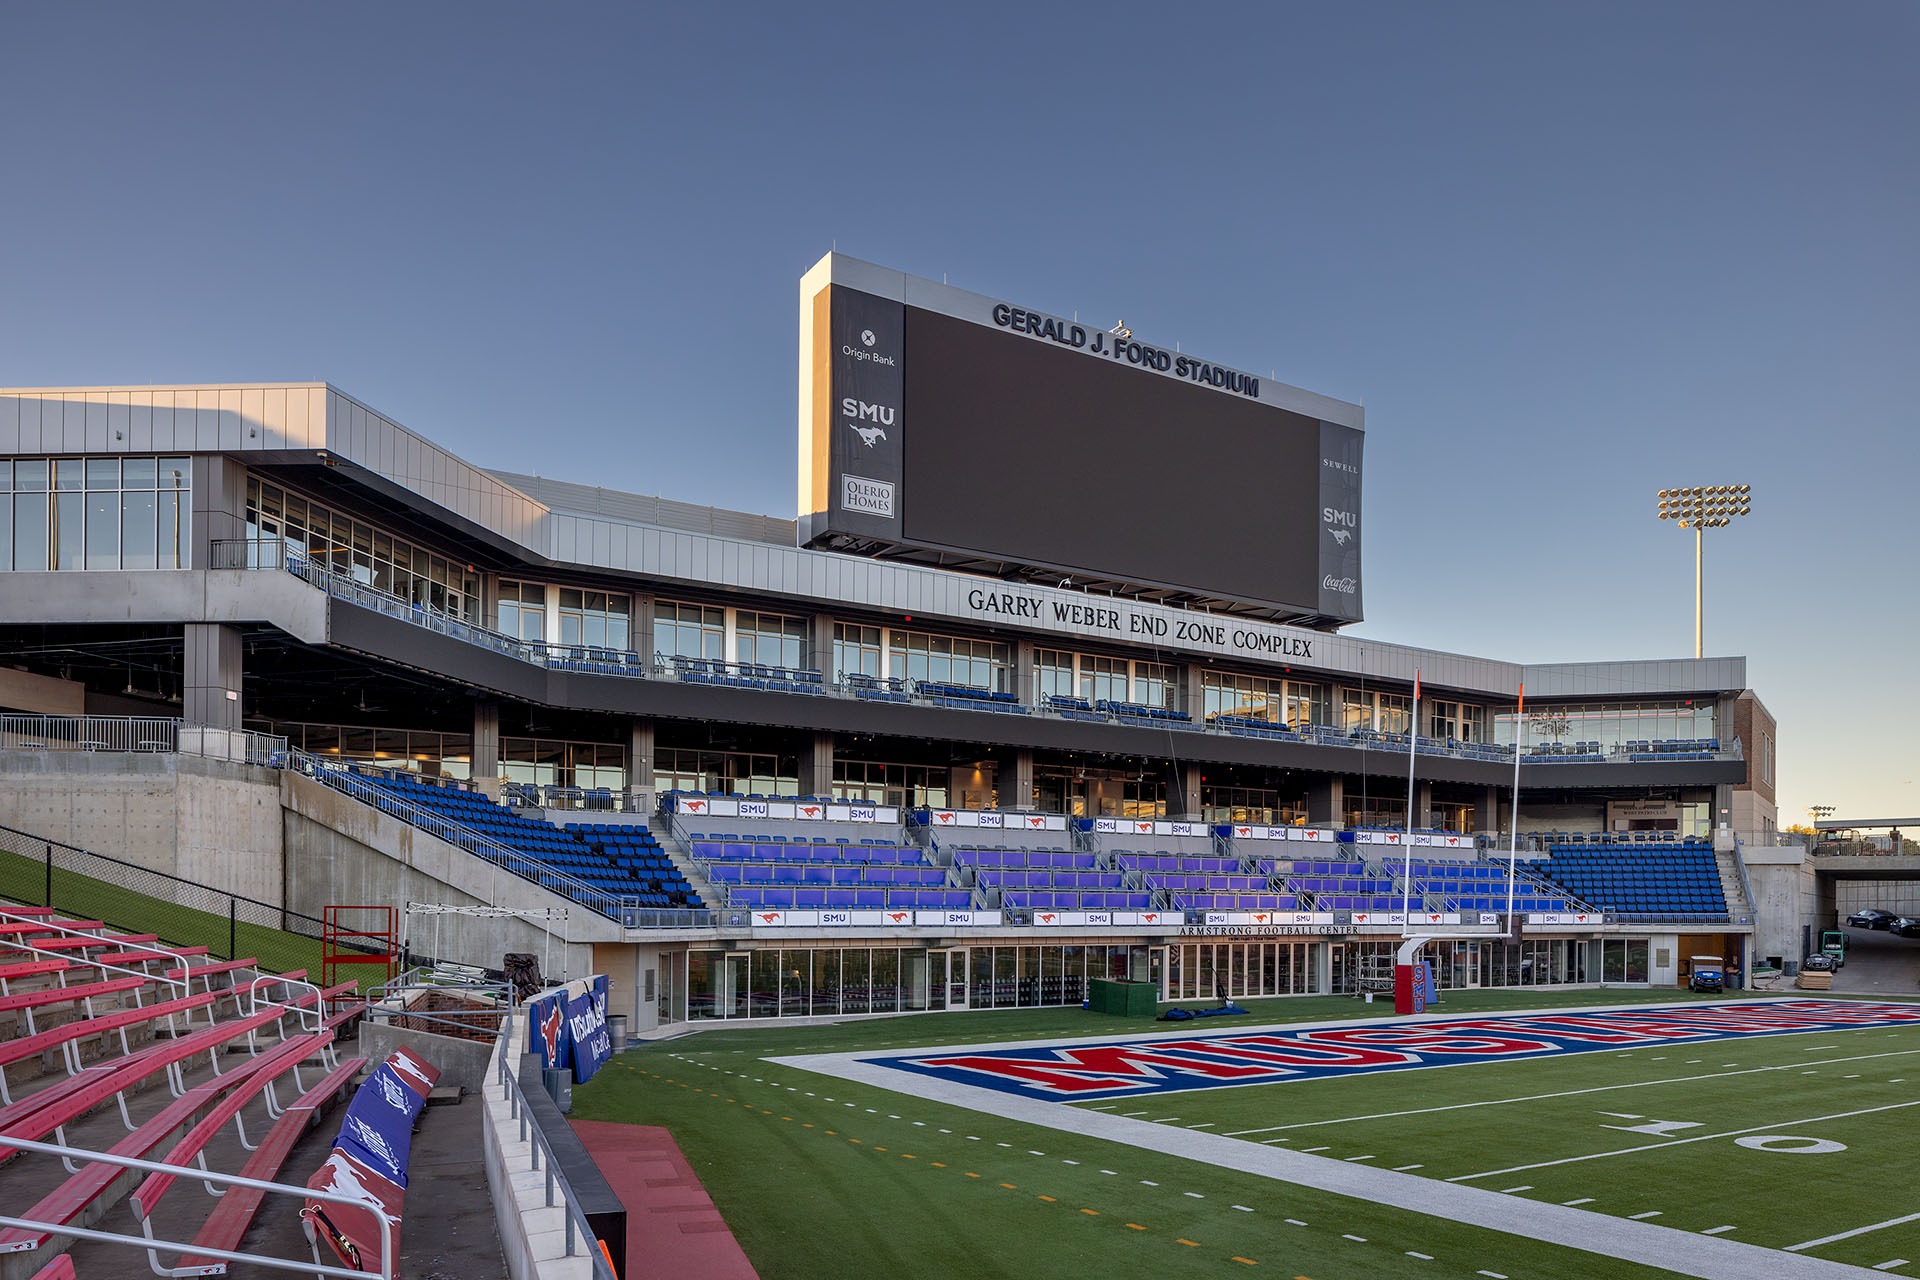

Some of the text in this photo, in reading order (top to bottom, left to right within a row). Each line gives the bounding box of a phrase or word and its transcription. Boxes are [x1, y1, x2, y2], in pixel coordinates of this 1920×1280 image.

[842, 345, 895, 367] Origin Bank
[993, 304, 1259, 398] GERALD J. FORD STADIUM
[842, 398, 895, 426] SMU
[1323, 458, 1358, 474] SEWELL
[847, 480, 890, 499] OLERIO
[848, 492, 889, 511] HOMES
[1323, 507, 1357, 528] SMU
[968, 588, 1313, 659] GARRY WEBER END ZONE COMPLEX
[740, 804, 766, 815] SMU
[851, 809, 874, 819] SMU
[980, 815, 1001, 825] SMU
[1097, 821, 1116, 831] SMU
[1172, 825, 1191, 834] SMU
[1269, 829, 1286, 838] SMU
[1356, 833, 1371, 842] SMU
[1416, 836, 1430, 844] SMU
[823, 913, 847, 922] SMU
[949, 913, 970, 923] SMU
[1089, 914, 1108, 923] SMU
[1208, 915, 1225, 923] SMU
[1295, 915, 1311, 923] SMU
[1180, 926, 1359, 936] ARMSTRONG FOOTBALL CENTER
[1413, 967, 1424, 1012] SMU
